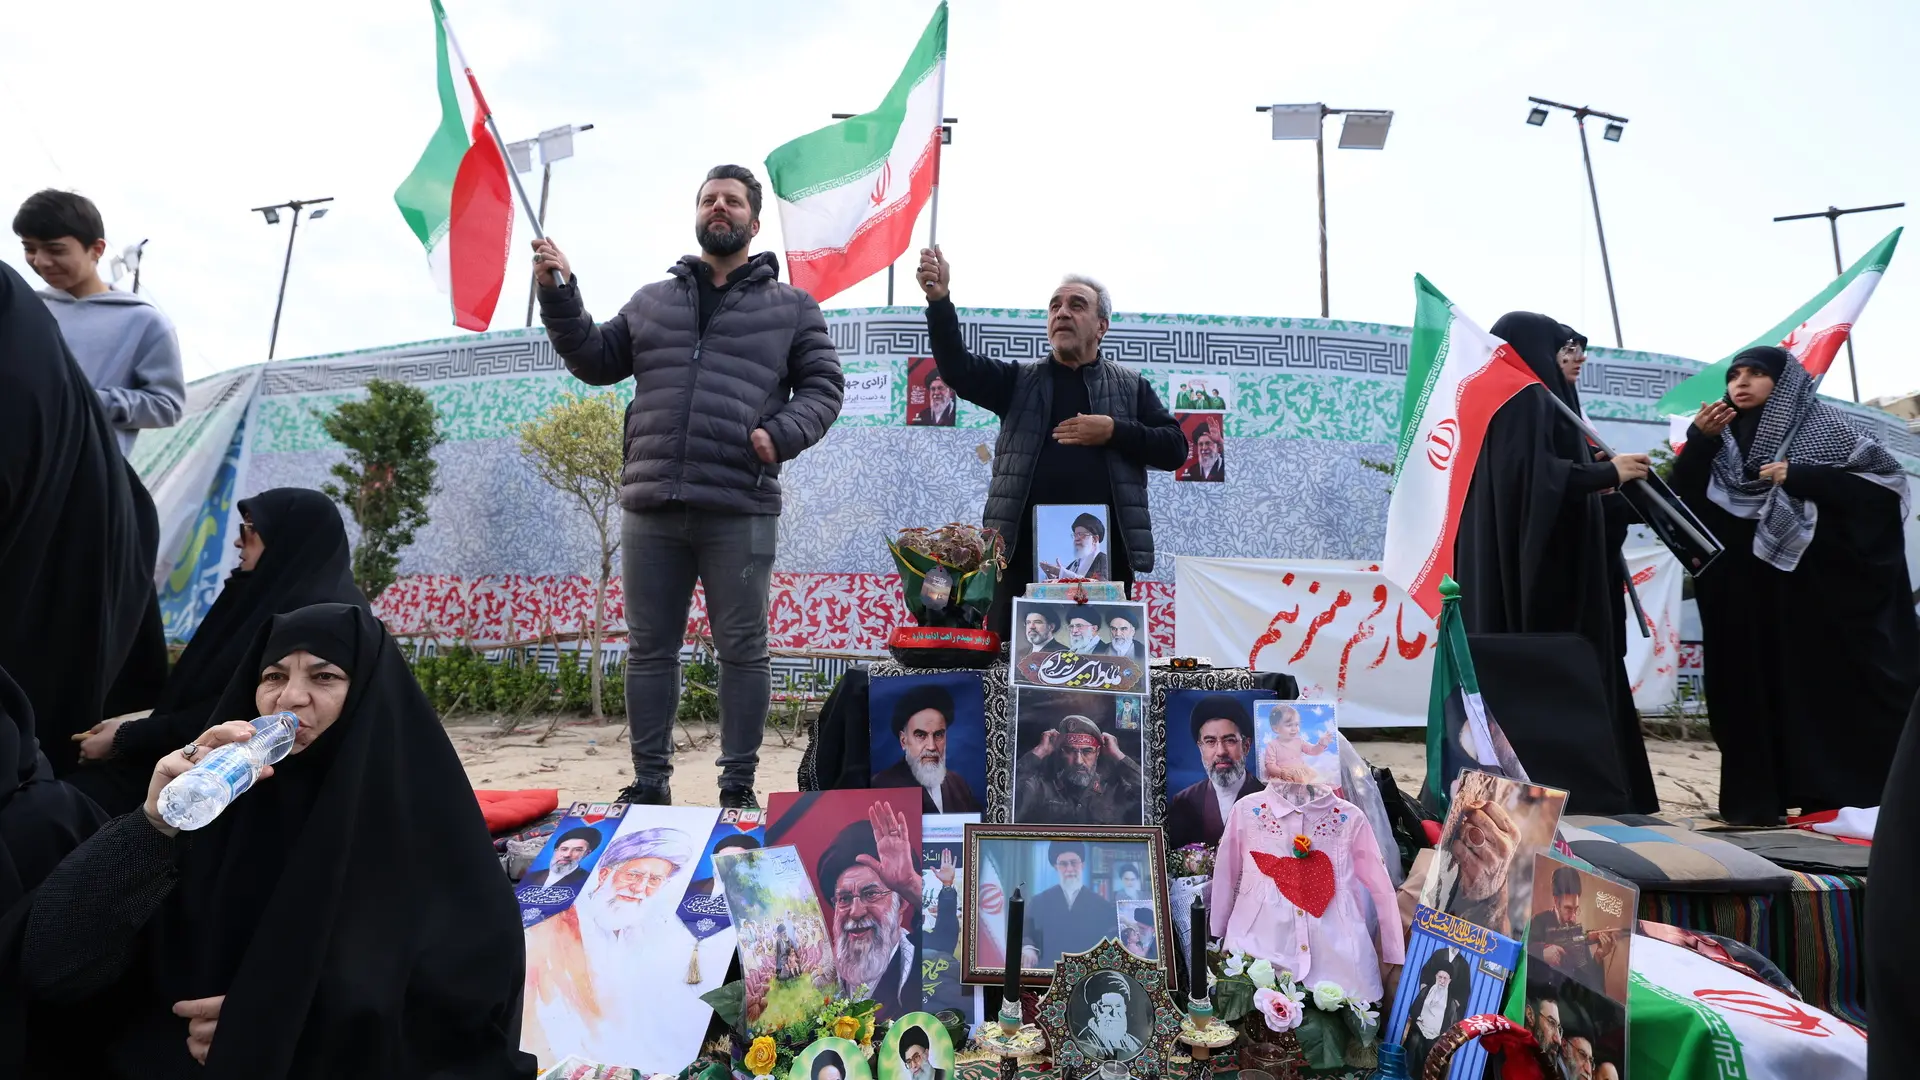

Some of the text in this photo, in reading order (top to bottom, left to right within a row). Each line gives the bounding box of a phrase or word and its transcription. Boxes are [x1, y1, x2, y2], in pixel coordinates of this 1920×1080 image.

[844, 375, 887, 389] آزادی جها
[860, 393, 878, 401] دست
[912, 632, 924, 642] دارد
[924, 631, 939, 640] ادامه
